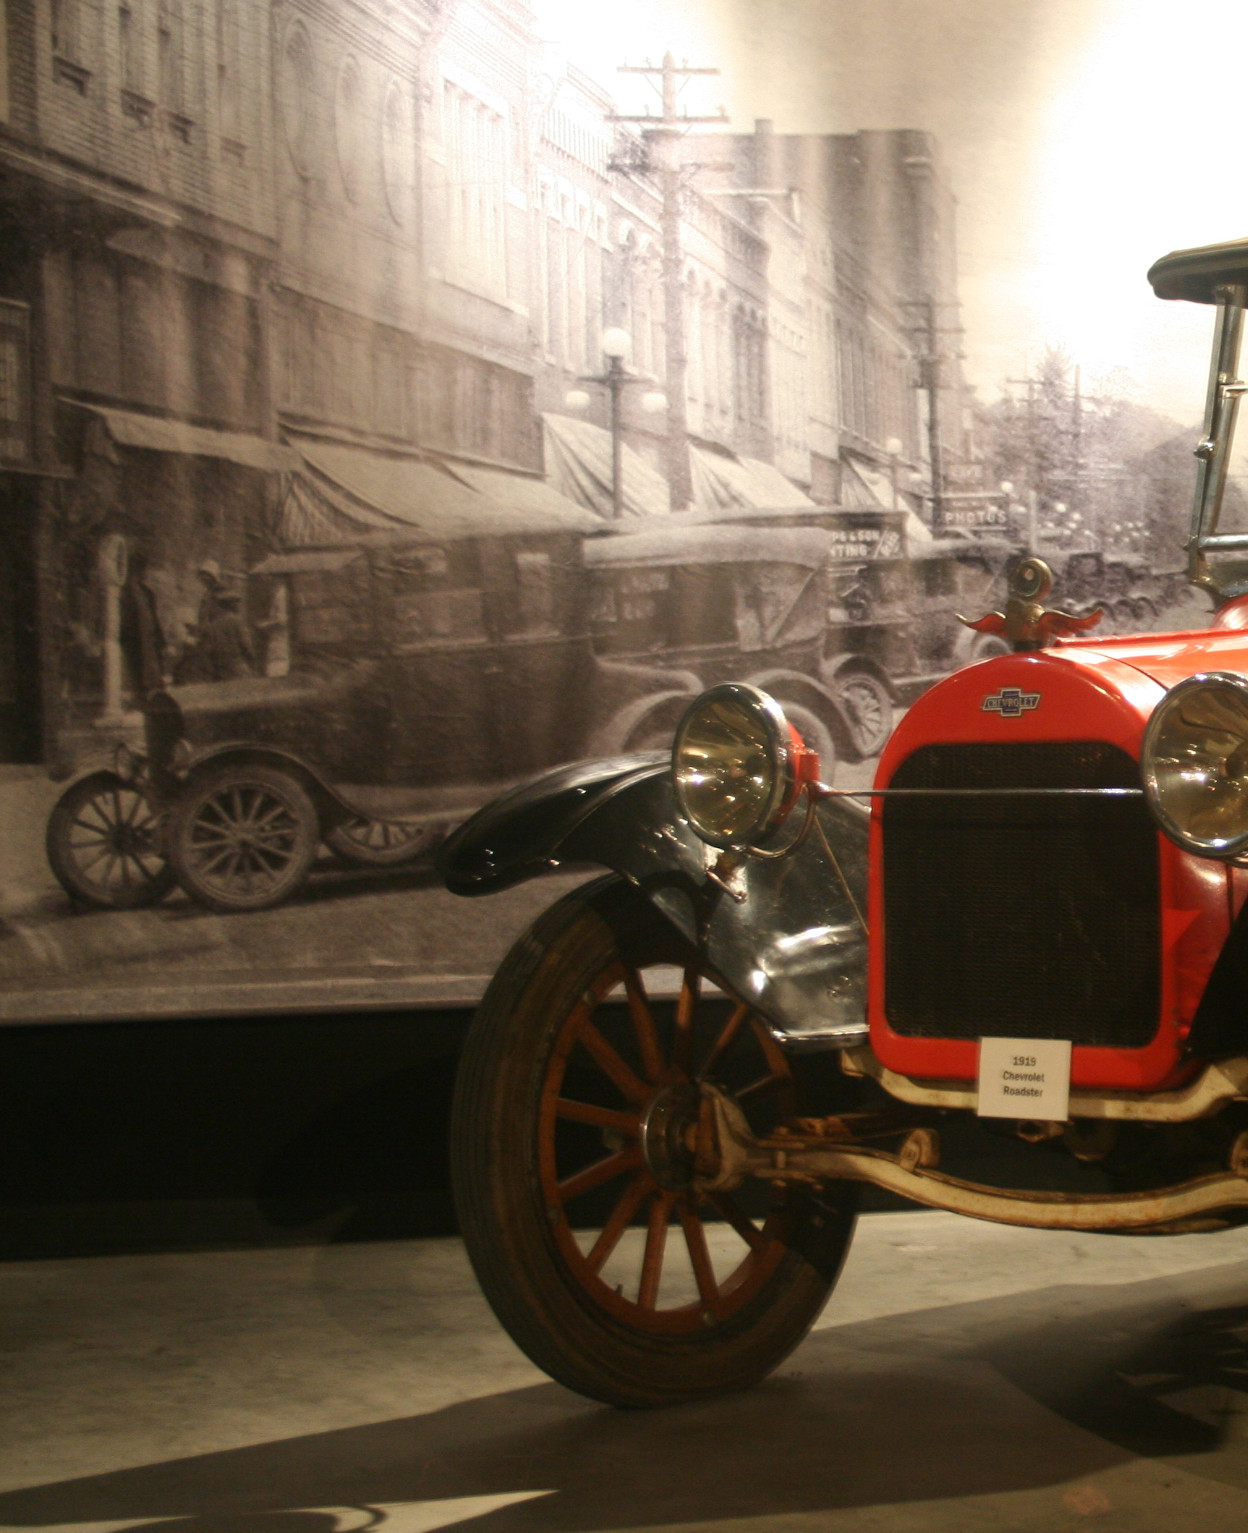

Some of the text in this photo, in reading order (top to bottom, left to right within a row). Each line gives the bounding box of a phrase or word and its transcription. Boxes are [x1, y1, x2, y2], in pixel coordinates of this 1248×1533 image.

[986, 697, 1035, 708] CHEVROLET
[1013, 1056, 1036, 1067] 1919
[1003, 1071, 1045, 1082] Chevrolet
[1003, 1086, 1043, 1097] Roadster
